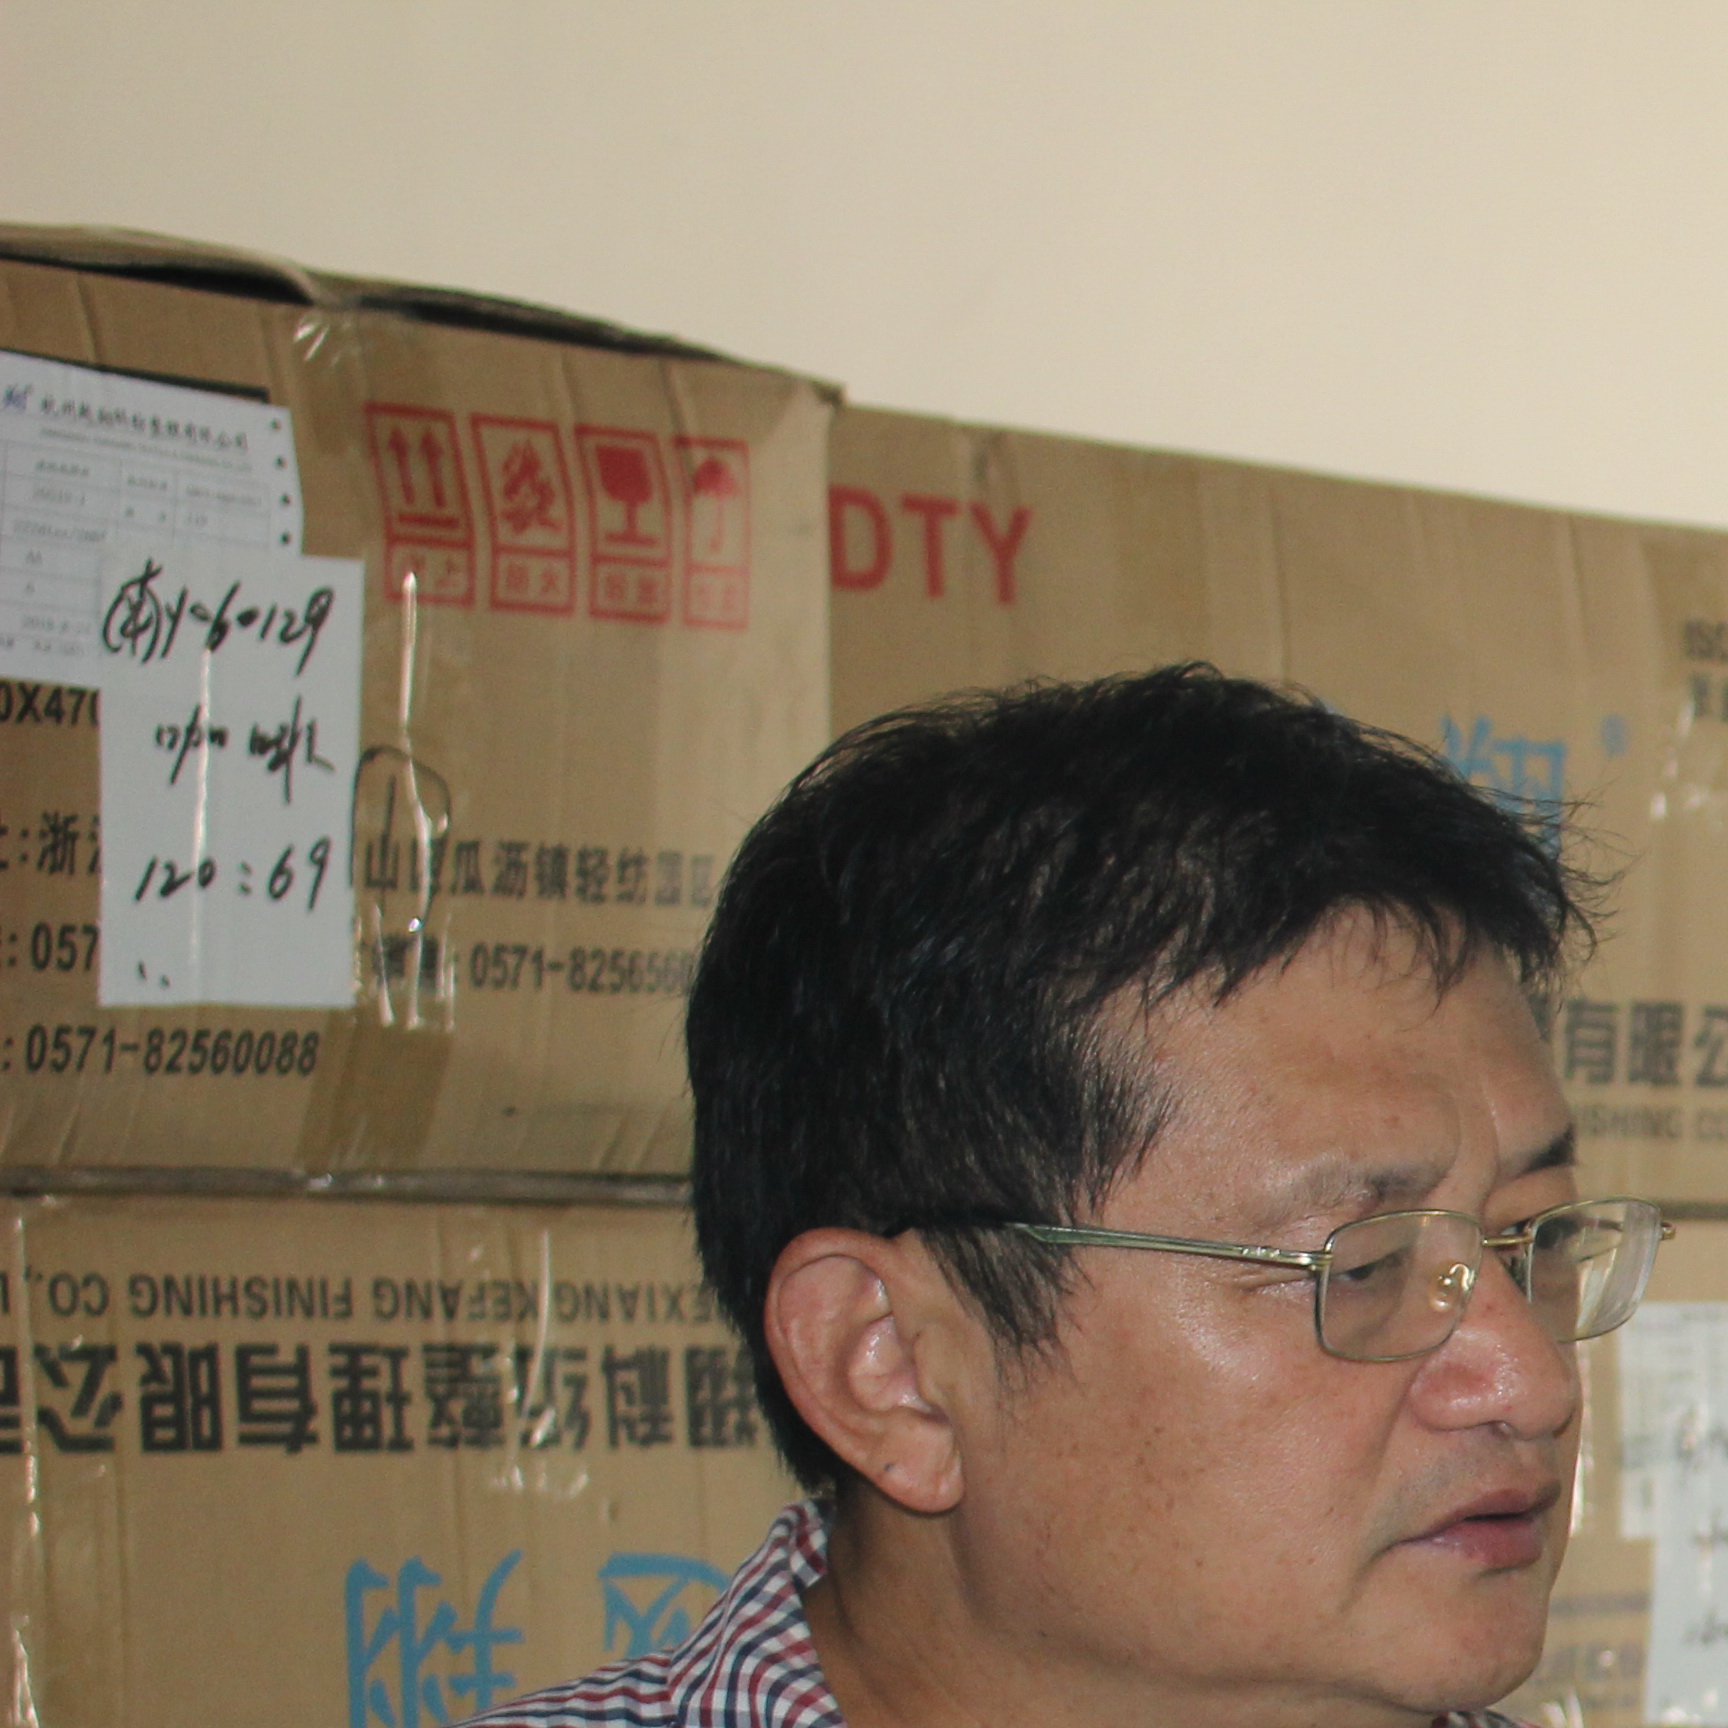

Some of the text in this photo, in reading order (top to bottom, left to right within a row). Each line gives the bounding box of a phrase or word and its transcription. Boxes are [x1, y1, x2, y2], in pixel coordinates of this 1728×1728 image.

[828, 484, 1033, 608] DTY
[129, 1274, 353, 1321] FINISHING
[373, 1278, 535, 1323] KEFANG
